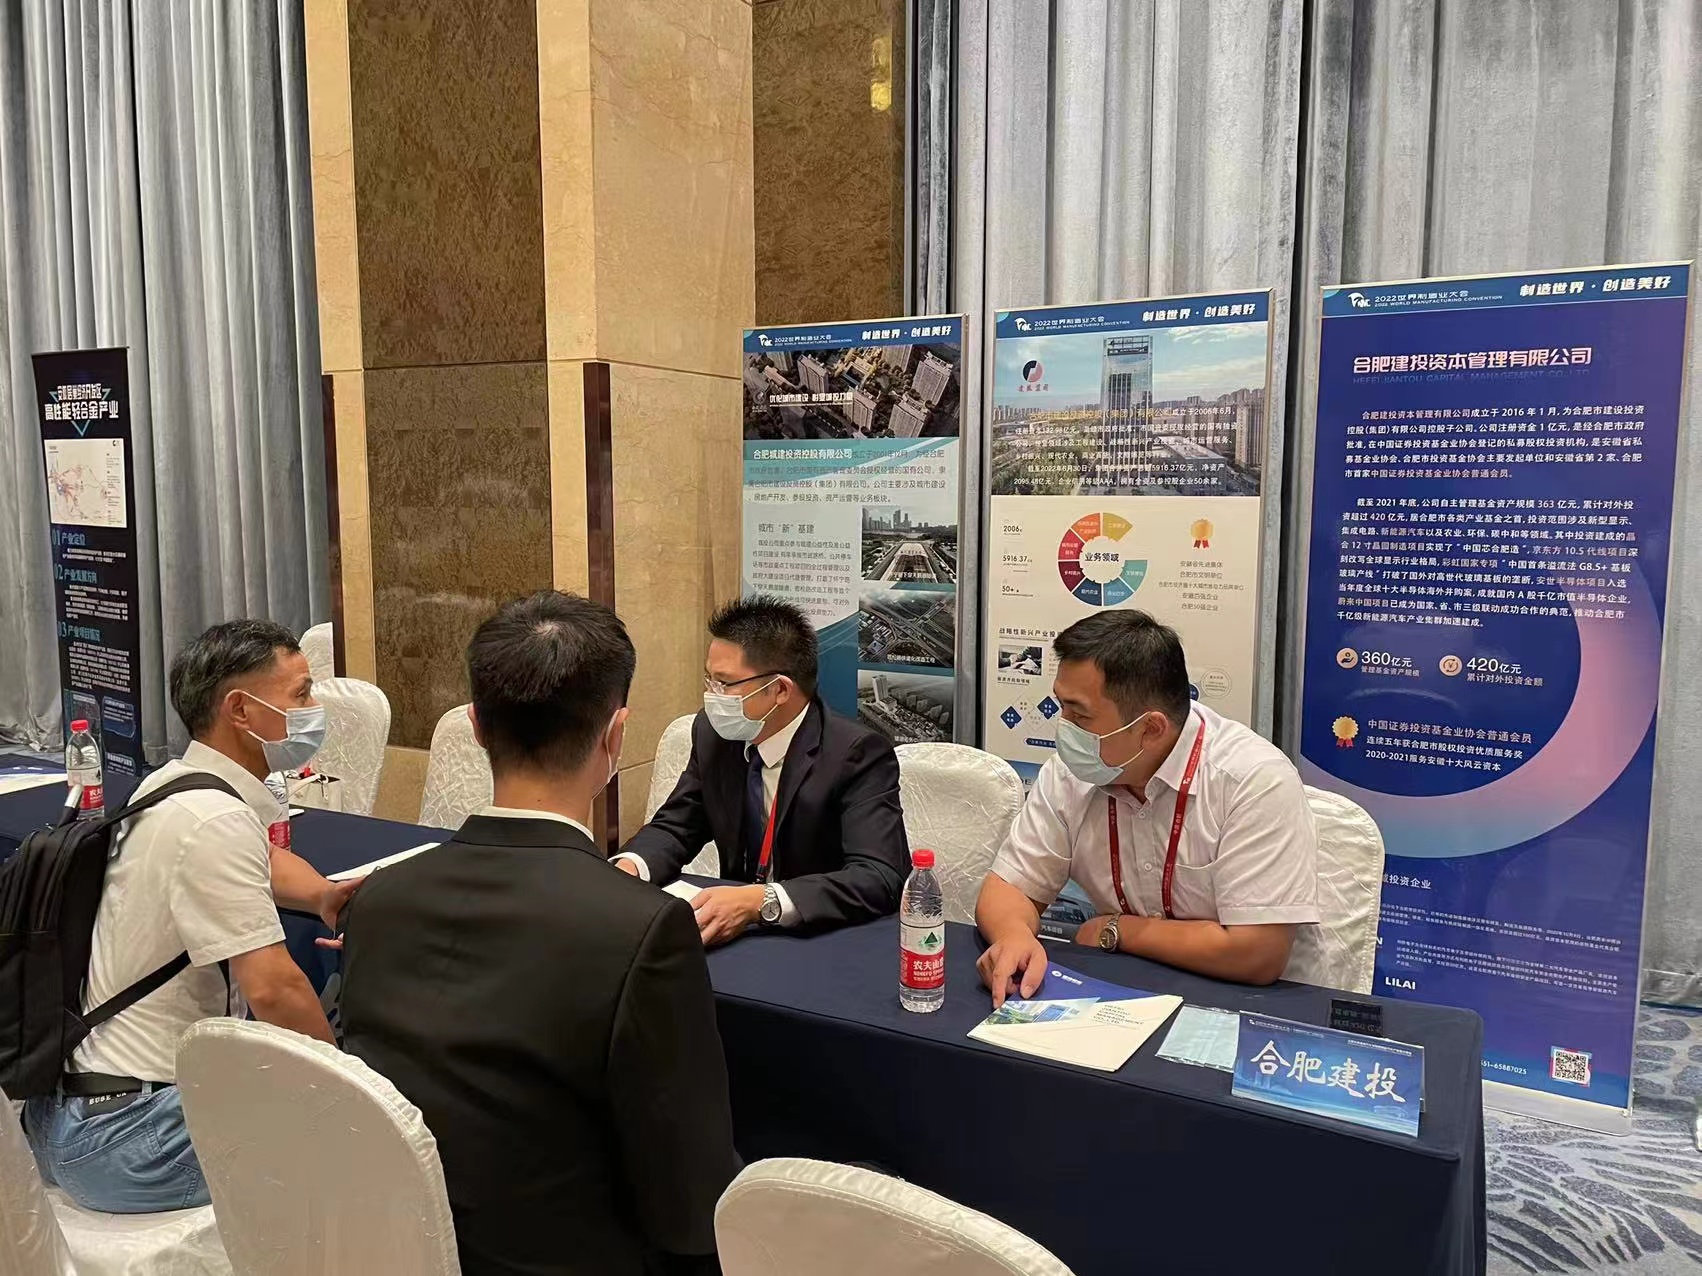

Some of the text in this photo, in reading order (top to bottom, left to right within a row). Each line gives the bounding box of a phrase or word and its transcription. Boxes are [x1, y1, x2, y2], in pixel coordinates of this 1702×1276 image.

[1353, 347, 1592, 374] 合肥建投资本管理有限公司
[44, 400, 119, 420] 高性能轻合金产业
[1003, 525, 1022, 533] 2006
[1085, 552, 1119, 562] 业务领域
[1467, 672, 1544, 687] 累计对外投资金额
[1367, 719, 1532, 744] 中国证券投资基金业协会普通会员
[1366, 735, 1523, 760] 连续五年获合肥市股权投资优质服务奖
[1385, 976, 1416, 990] LILAI
[1250, 1040, 1406, 1103] 合肥建投
